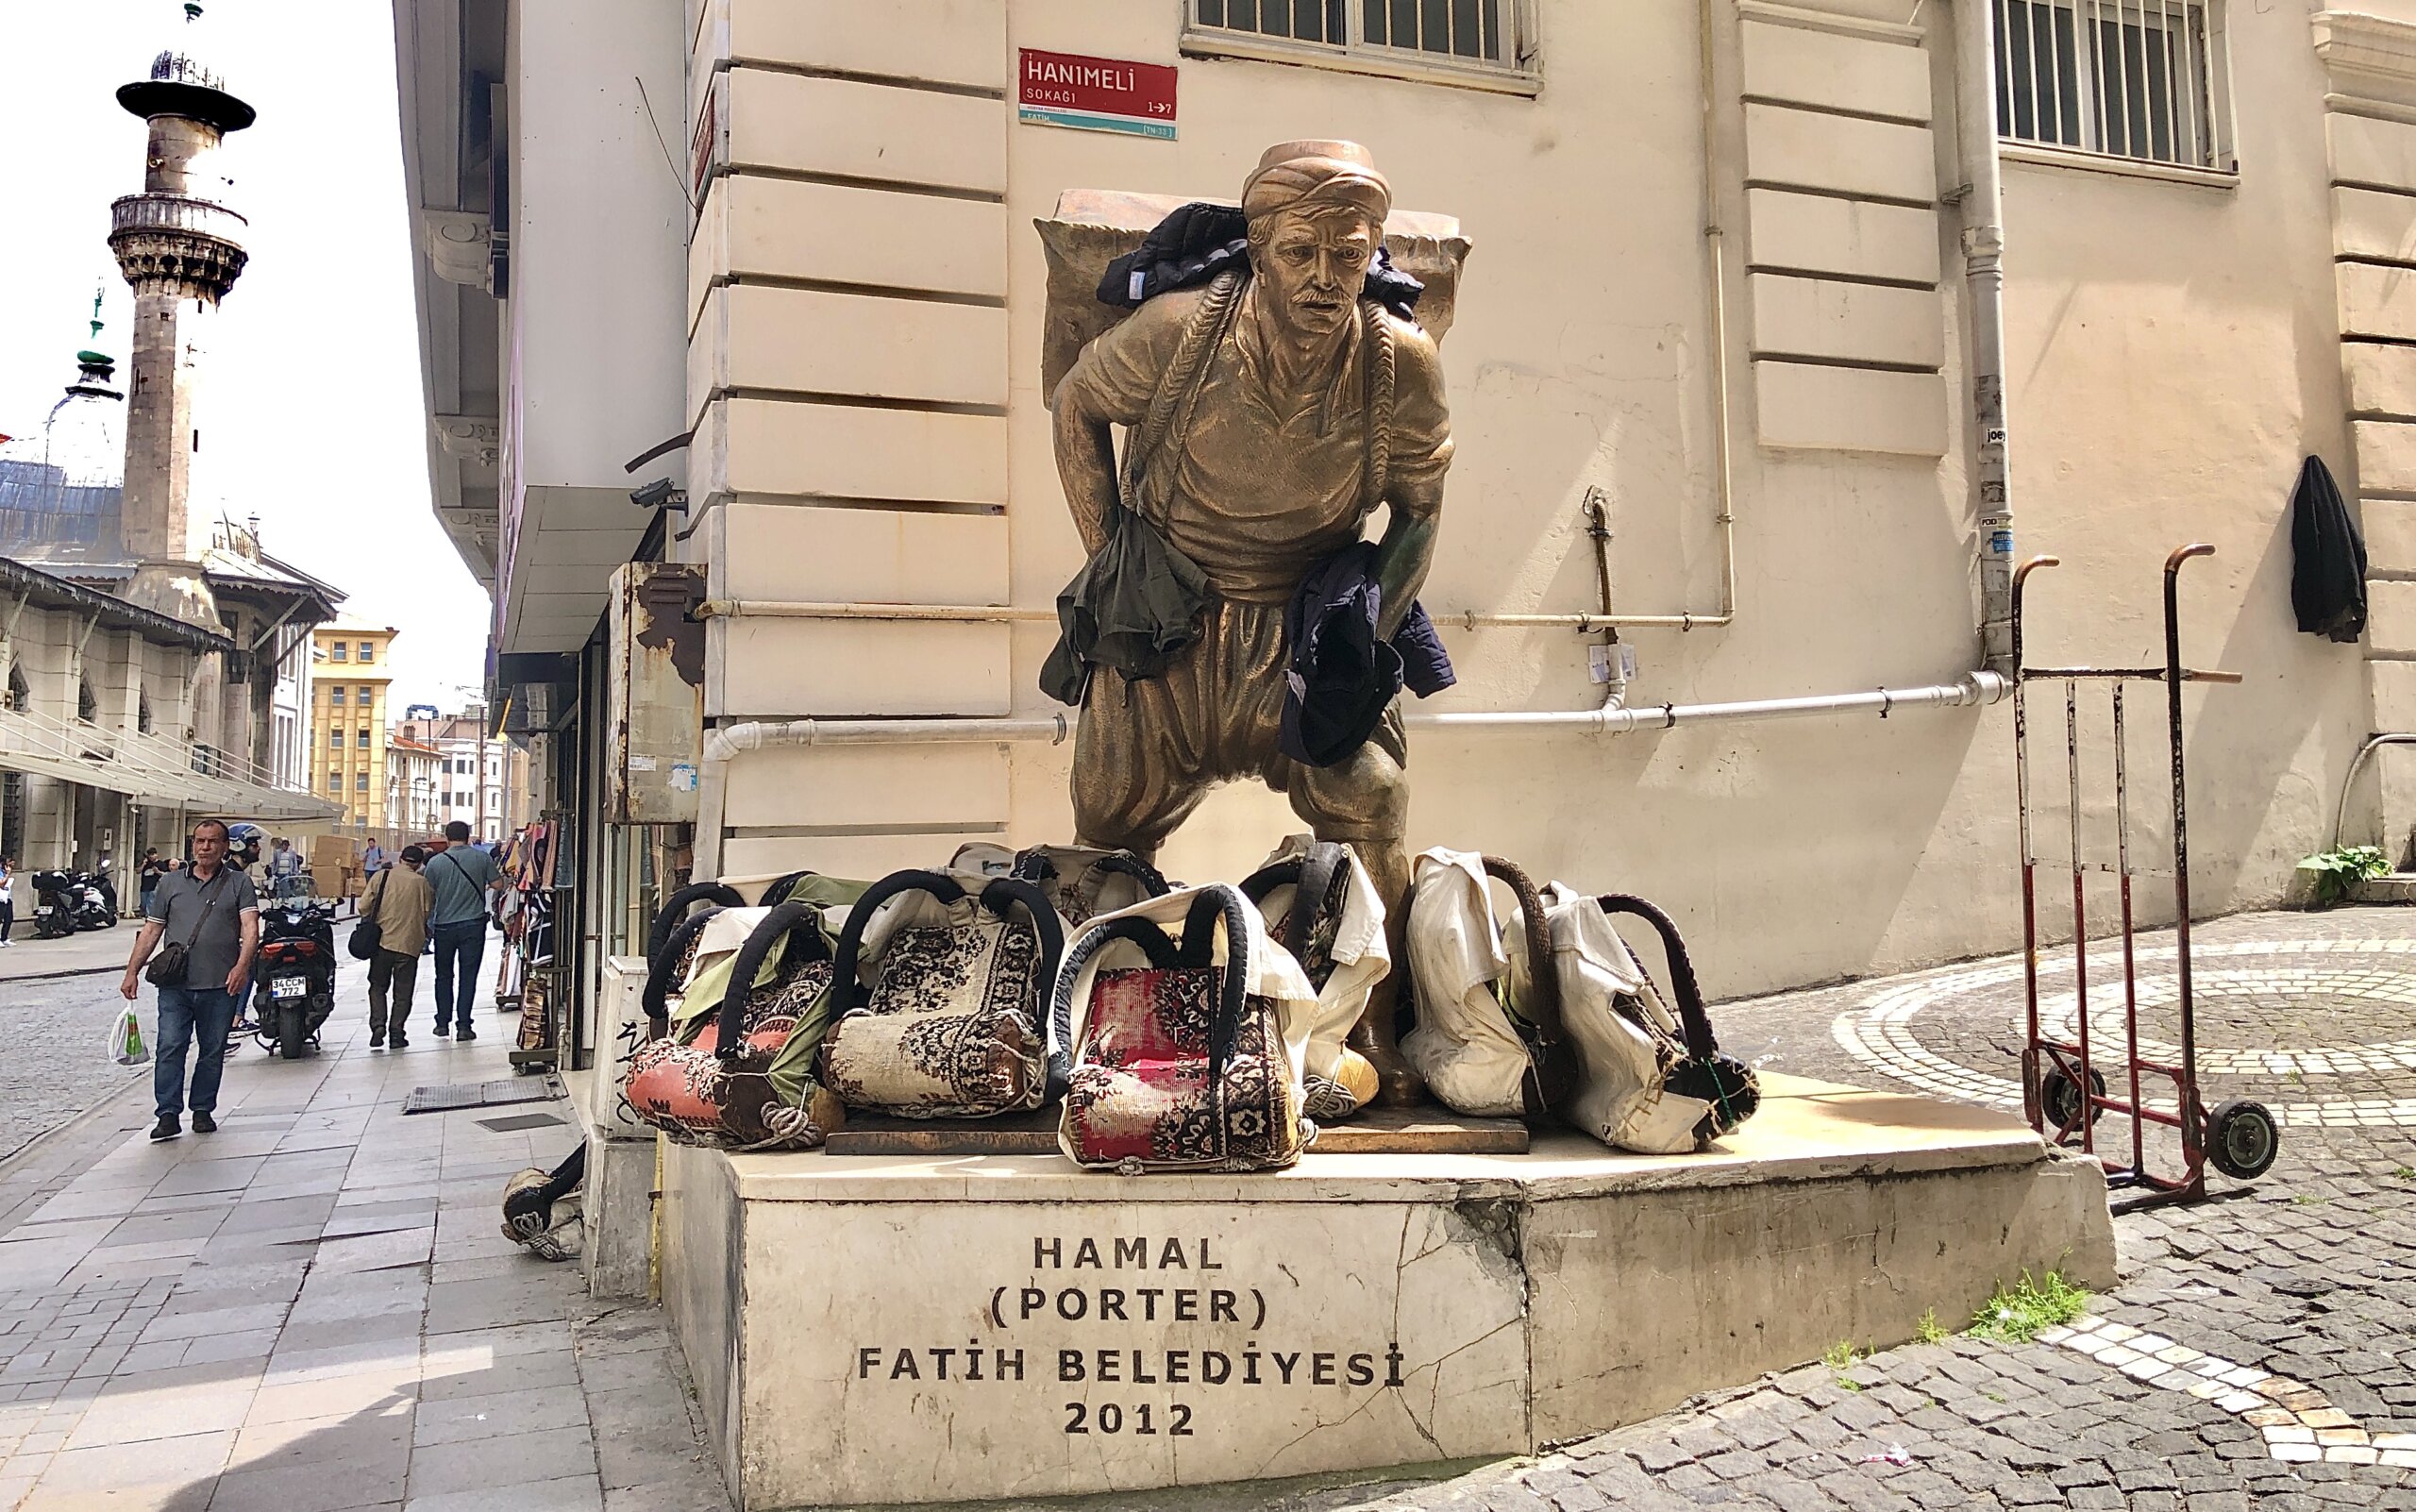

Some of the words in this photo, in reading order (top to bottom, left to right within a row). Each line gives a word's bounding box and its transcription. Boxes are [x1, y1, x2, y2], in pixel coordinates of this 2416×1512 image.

[1028, 60, 1134, 92] HANIMELİ
[1026, 87, 1075, 103] SOKAĞI
[1987, 428, 2006, 443] joey
[273, 980, 284, 988] 34
[282, 987, 299, 996] 772
[1034, 1237, 1222, 1269] HAMAL
[991, 1286, 1266, 1331] (PORTER)
[860, 1338, 1024, 1381] FATİH
[1058, 1342, 1405, 1387] BELEDİYESİ
[1065, 1403, 1194, 1436] 2012
